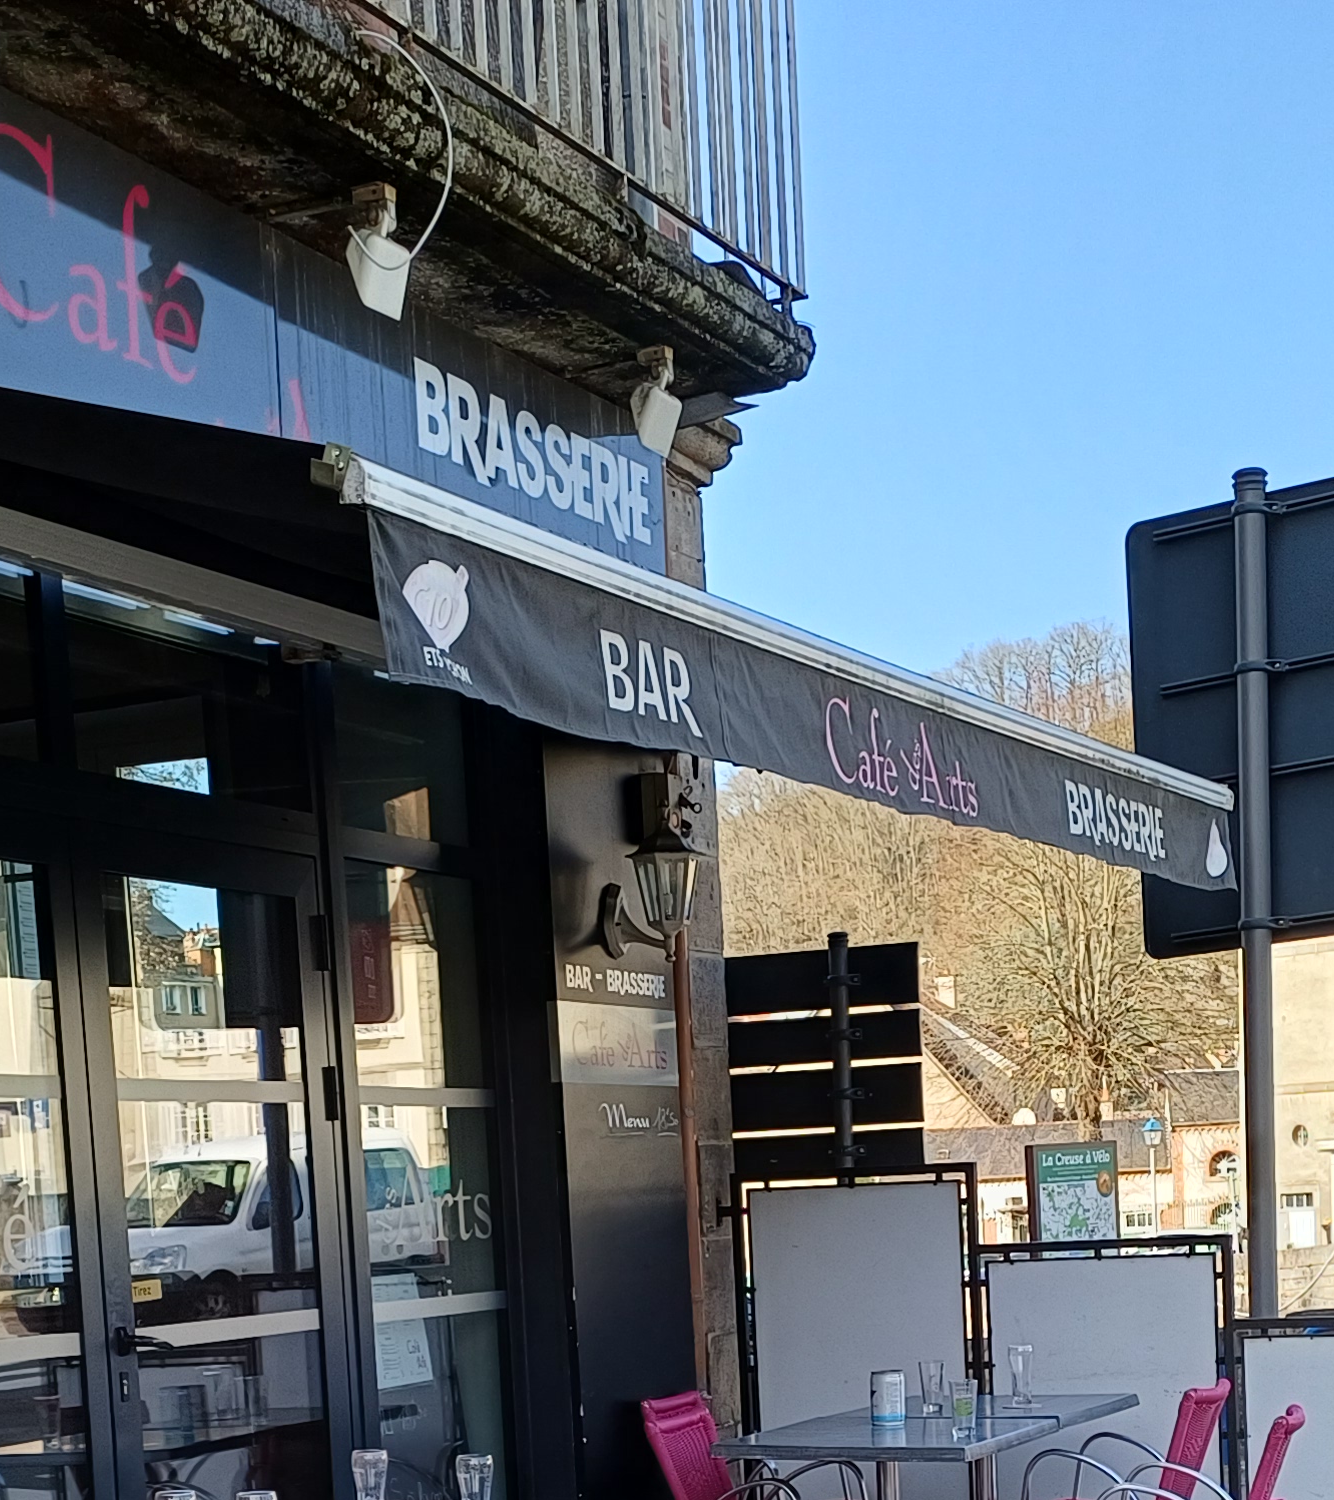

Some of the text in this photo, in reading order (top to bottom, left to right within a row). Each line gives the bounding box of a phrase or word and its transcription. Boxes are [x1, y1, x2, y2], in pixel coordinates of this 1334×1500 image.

[414, 356, 652, 545] BRASSERIE
[423, 645, 444, 668] ETS
[600, 628, 704, 738] BAR
[825, 698, 898, 796] Café
[920, 722, 978, 817] Arts
[1065, 779, 1166, 860] BRASSERIE
[566, 963, 593, 992] BAR
[606, 969, 665, 998] BRASSERIE
[572, 1020, 614, 1067] Café
[628, 1022, 667, 1069] Arts
[598, 1103, 650, 1128] Menu
[1042, 1149, 1110, 1166] La Creuse à Vélo
[394, 1160, 492, 1244] Arts
[133, 1286, 151, 1297] Tirez
